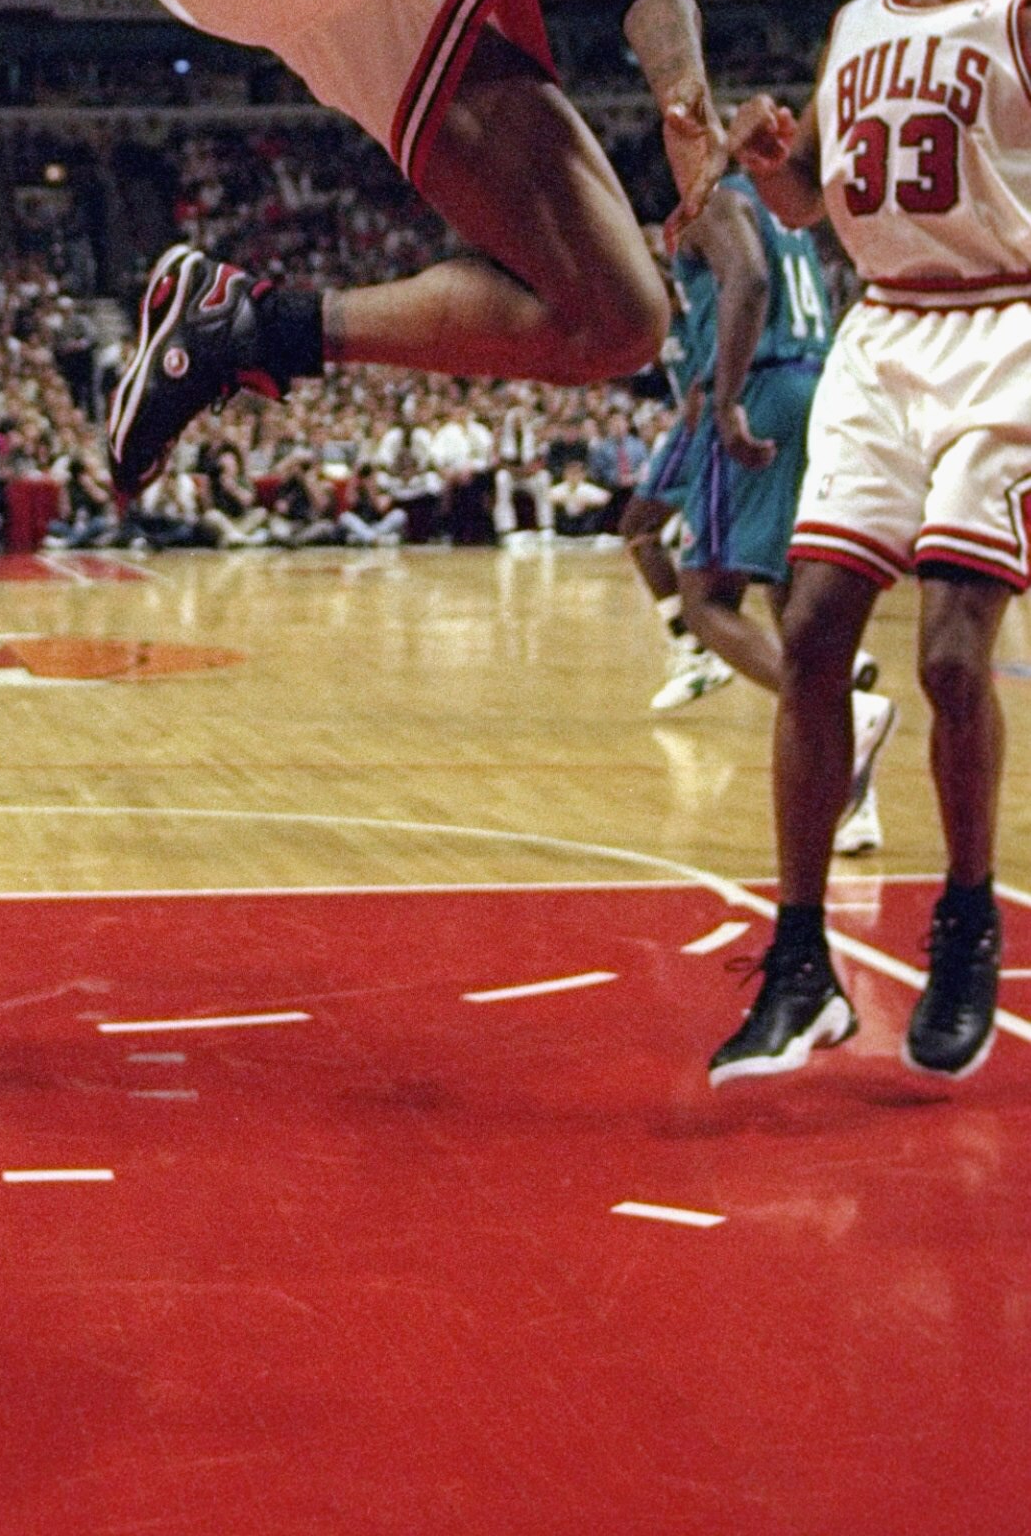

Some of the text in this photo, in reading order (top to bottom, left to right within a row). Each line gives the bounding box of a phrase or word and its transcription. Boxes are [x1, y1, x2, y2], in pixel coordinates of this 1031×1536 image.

[836, 36, 990, 142] BULLS
[843, 112, 960, 217] 33
[782, 253, 826, 342] 14
